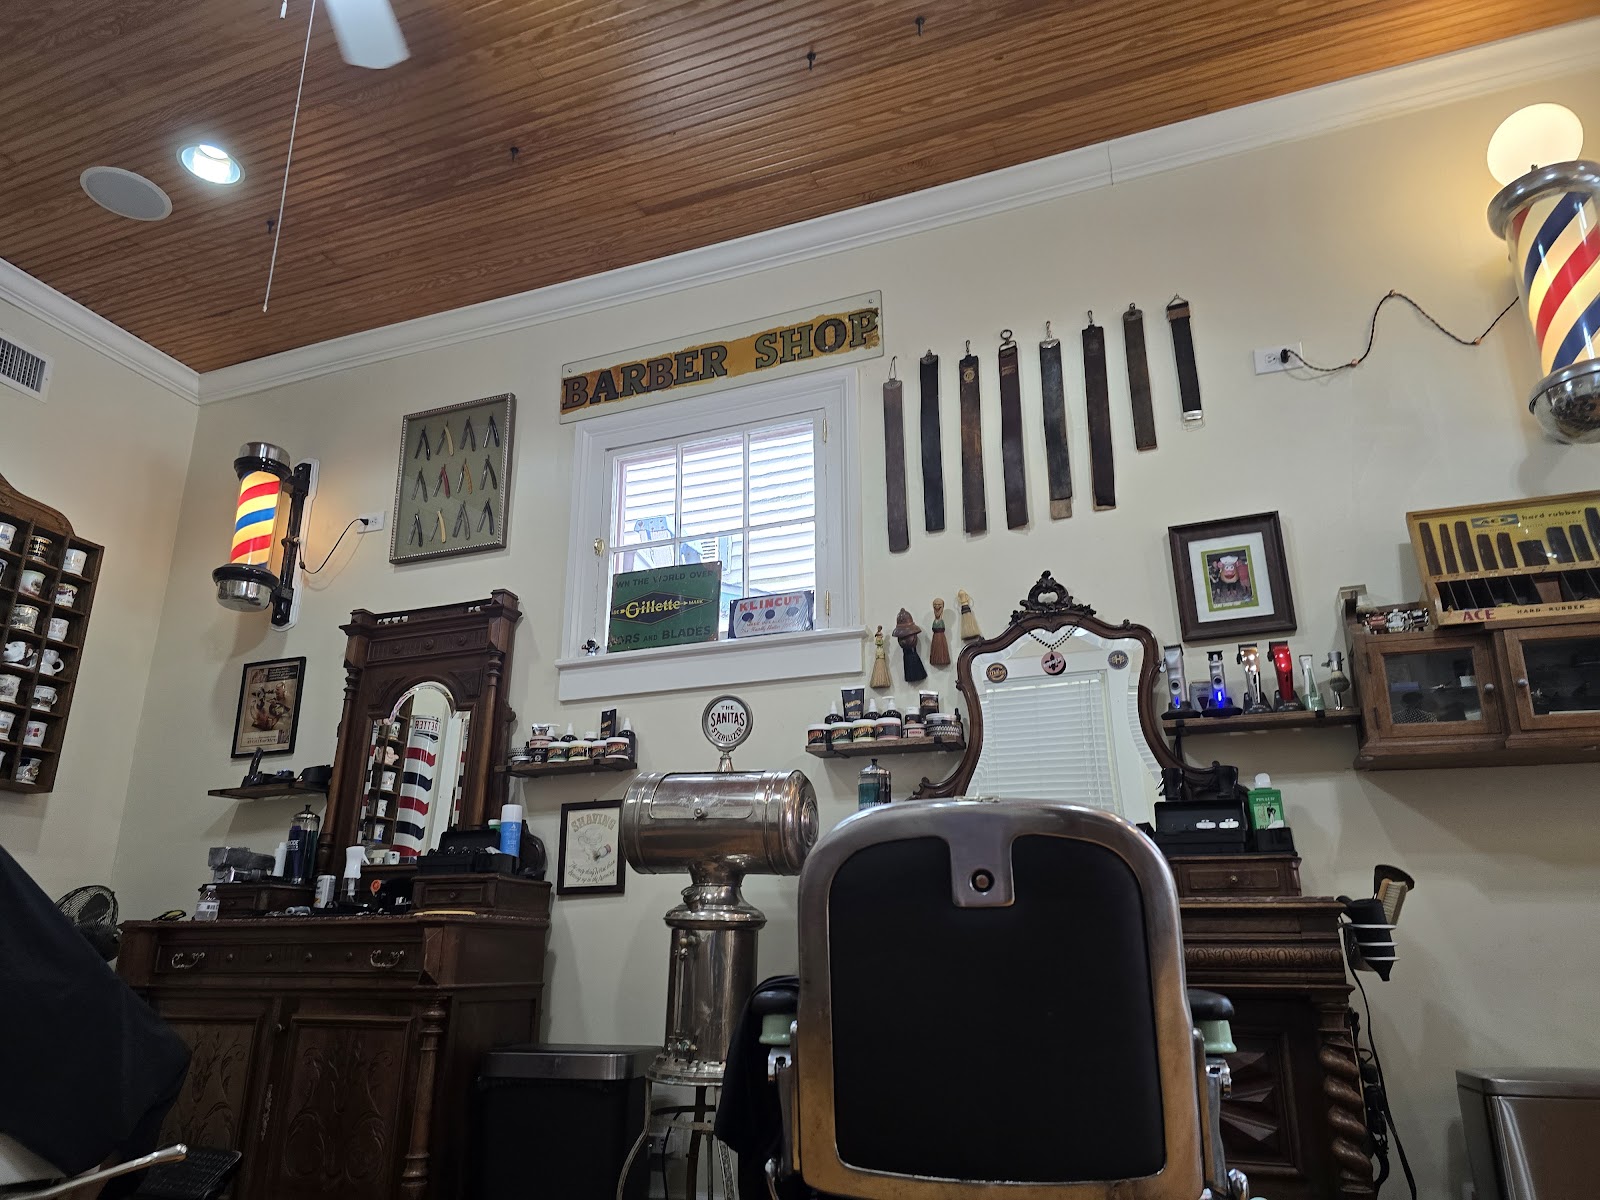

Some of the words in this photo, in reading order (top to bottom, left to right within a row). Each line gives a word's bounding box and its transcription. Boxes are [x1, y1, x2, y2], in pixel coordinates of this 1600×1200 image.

[562, 345, 727, 410] BARBER
[754, 309, 879, 369] SHOP
[633, 577, 649, 586] THE
[690, 570, 713, 579] OVER
[625, 598, 681, 618] Gillette
[739, 595, 802, 612] KLINCUT
[1463, 608, 1496, 621] ACE
[662, 625, 711, 640] BLADES
[711, 712, 745, 727] SANITAS
[712, 727, 744, 742] STERILIZER
[571, 813, 616, 832] SHAVING
